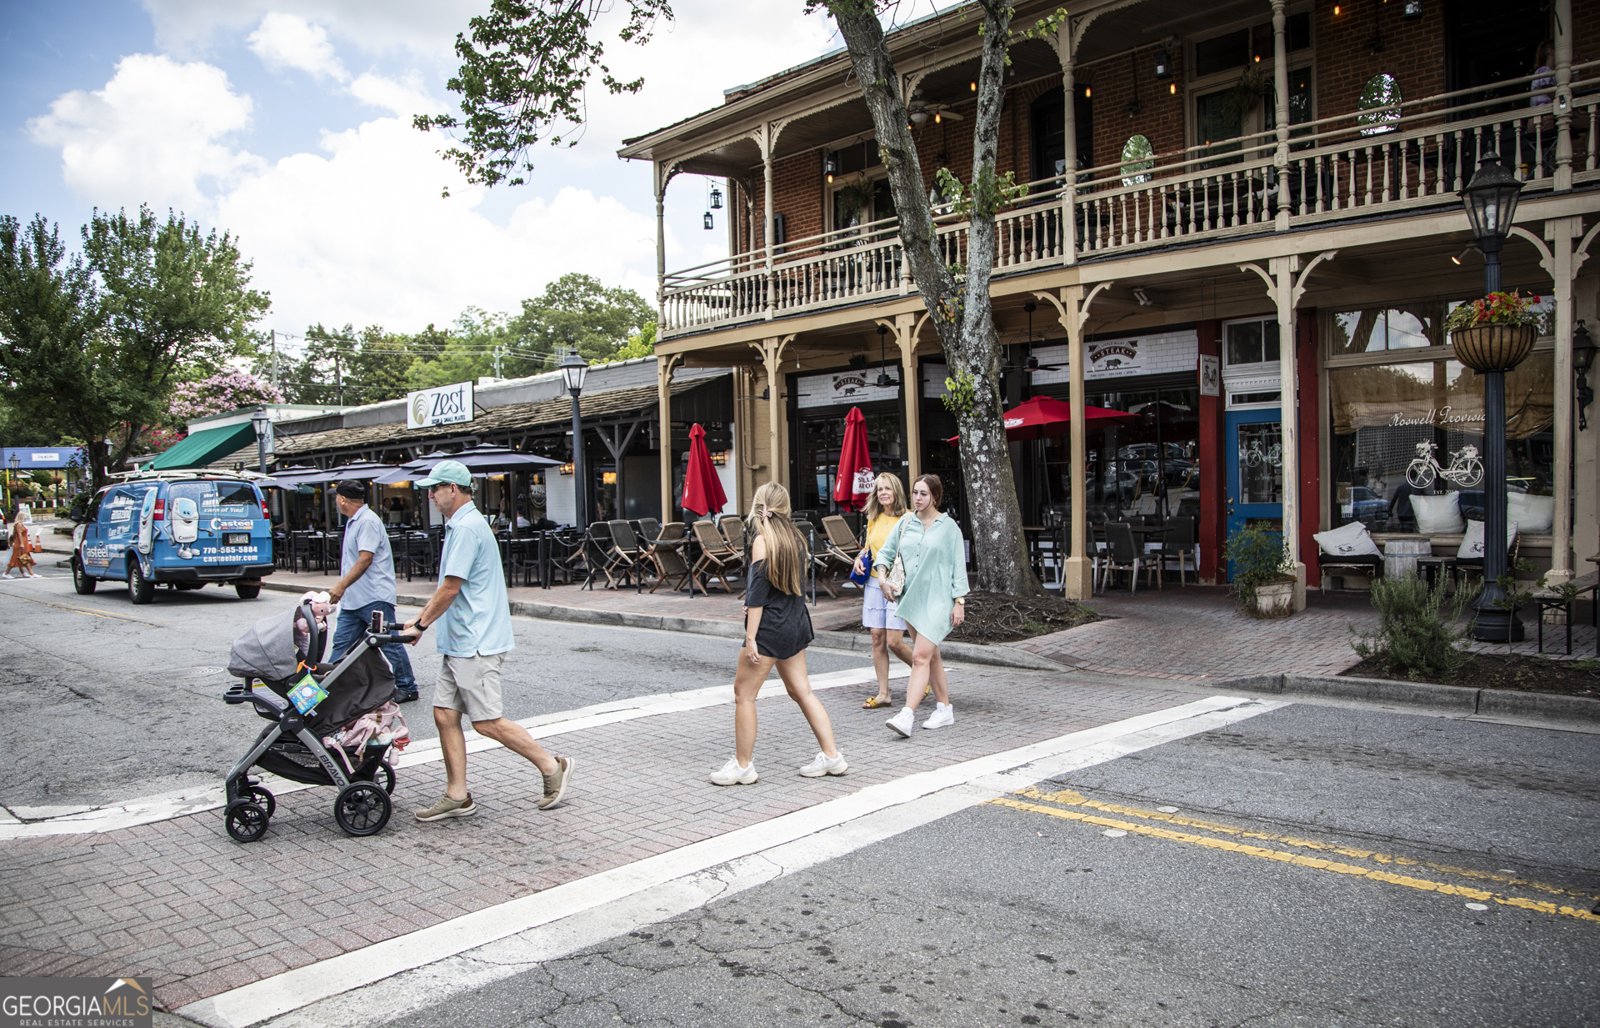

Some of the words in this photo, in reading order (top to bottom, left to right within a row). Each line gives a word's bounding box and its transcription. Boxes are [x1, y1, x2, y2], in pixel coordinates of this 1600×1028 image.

[1100, 347, 1126, 357] STEAK
[431, 384, 466, 417] Zest
[1389, 408, 1436, 427] Roswell
[211, 517, 254, 530] Casteel
[81, 540, 109, 565] Casteel
[203, 555, 258, 563] casteelair.com
[319, 755, 345, 787] BRAVO
